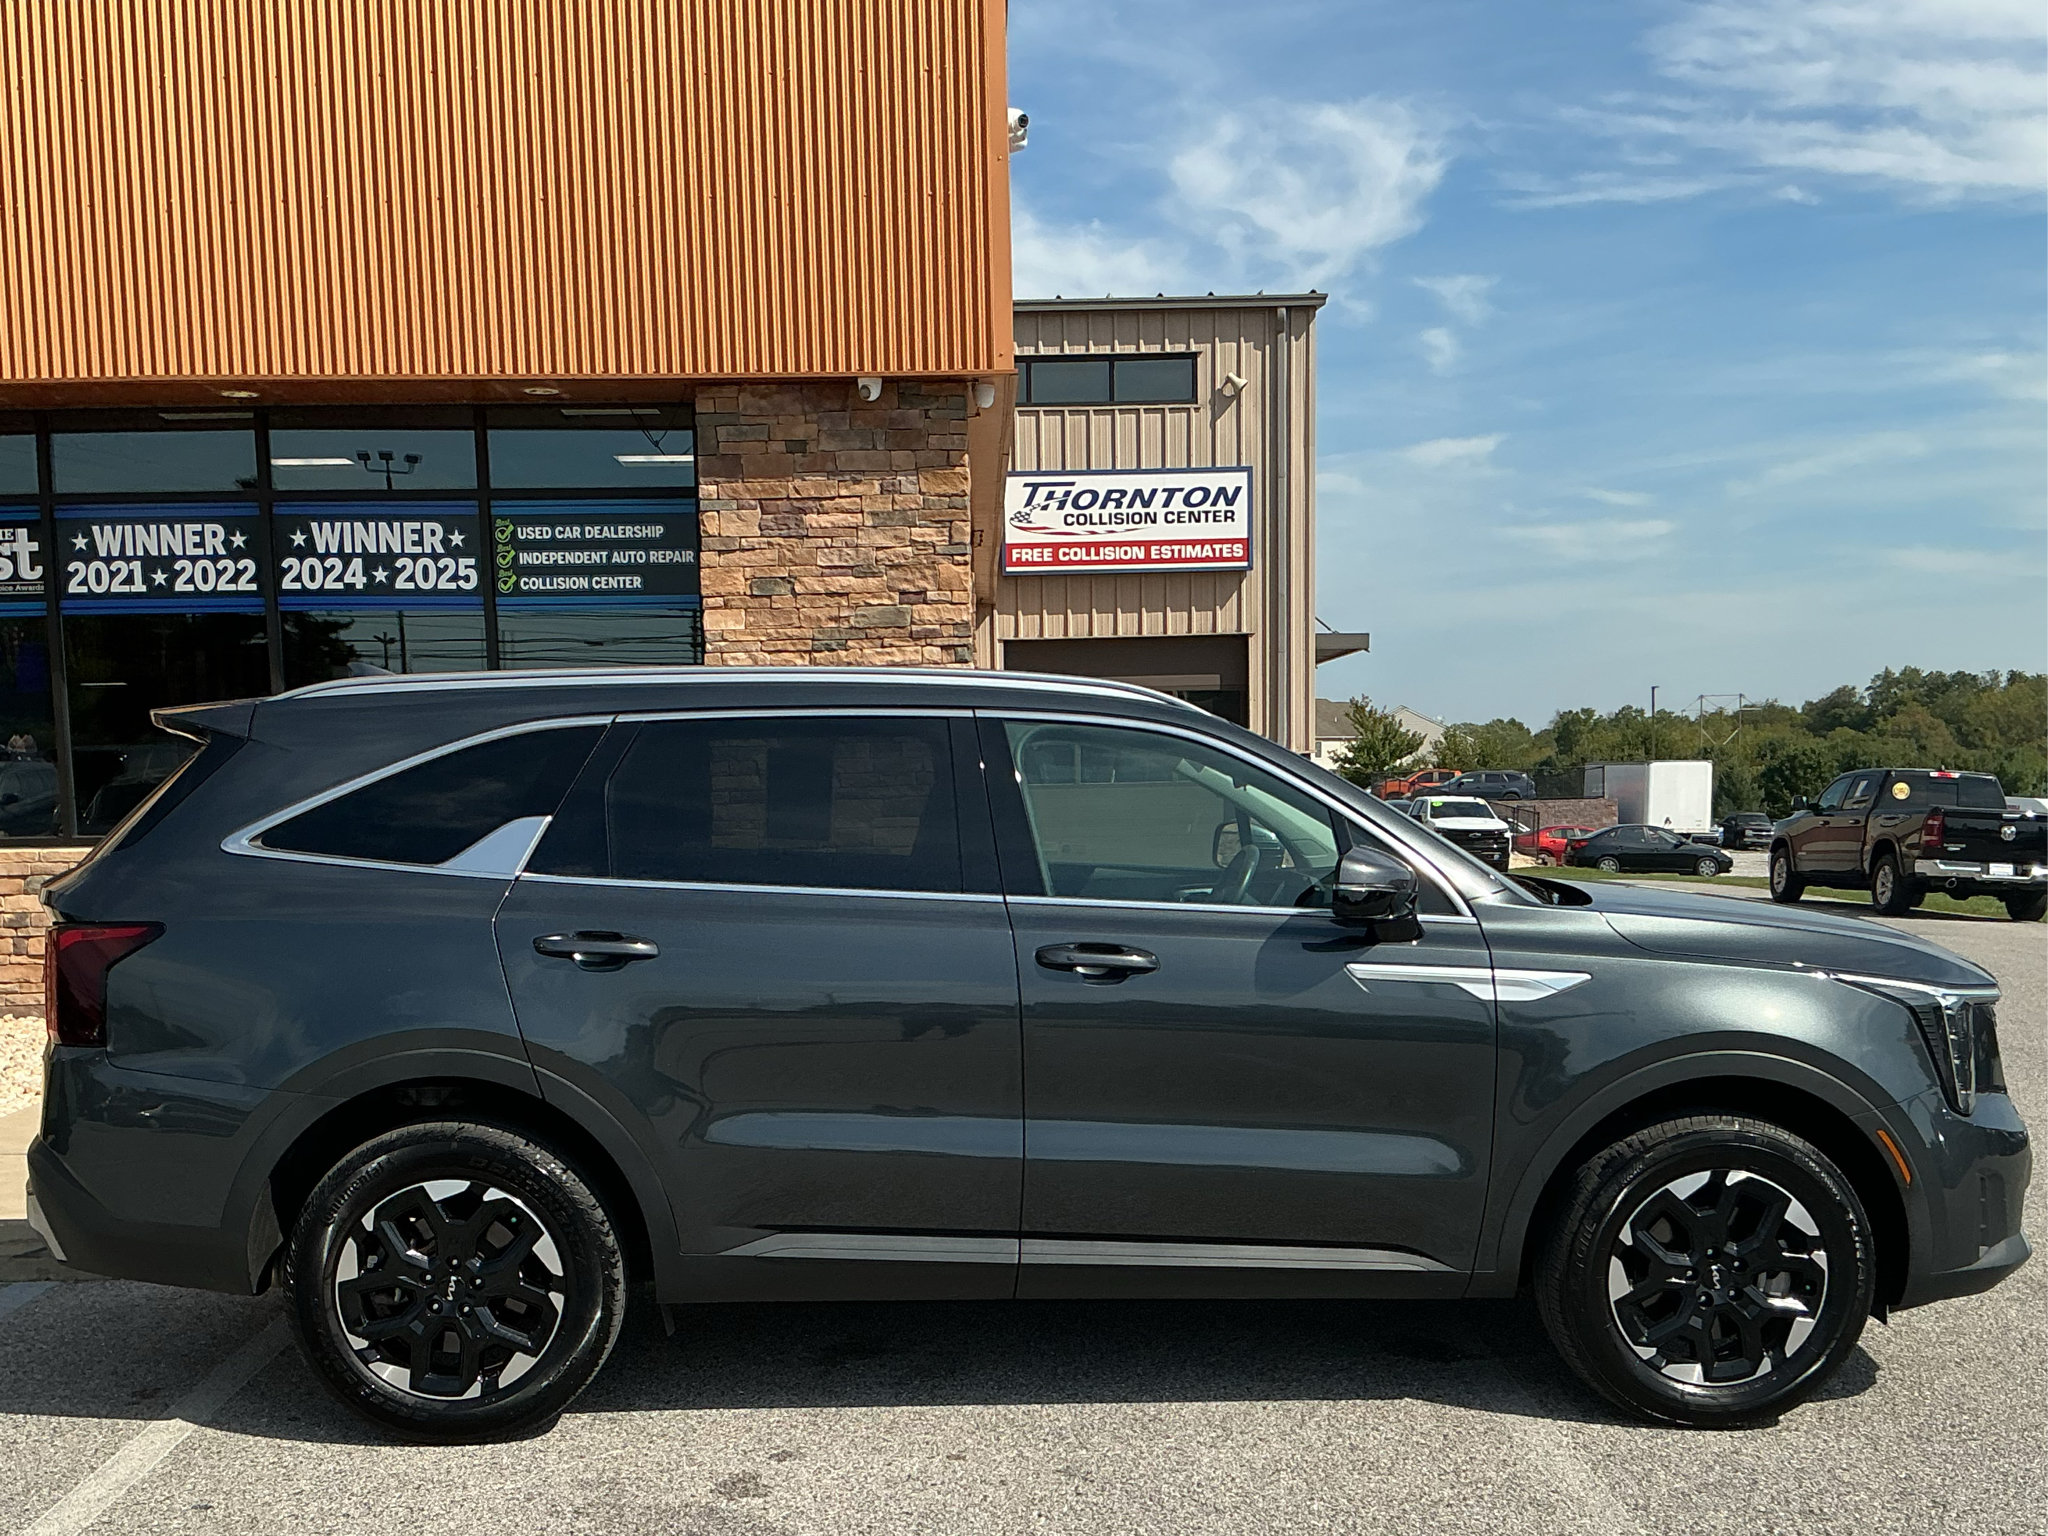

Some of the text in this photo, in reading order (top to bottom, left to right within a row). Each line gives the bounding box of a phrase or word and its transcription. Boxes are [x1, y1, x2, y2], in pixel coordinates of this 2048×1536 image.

[1022, 481, 1242, 511] THORNTON
[1063, 510, 1236, 527] COLLISION CENTER
[91, 523, 227, 557] WINNER
[310, 521, 444, 554] WINNER
[516, 525, 665, 540] USED CAR DEALERSHIP
[518, 549, 695, 565] INDEPENDENT AUTO REPAIR
[1011, 543, 1244, 562] FREE COLLISION ESTIMATES
[67, 558, 258, 594] 2021 2022
[280, 557, 478, 590] 2024 2025
[519, 575, 642, 591] COLLISION CENTER
